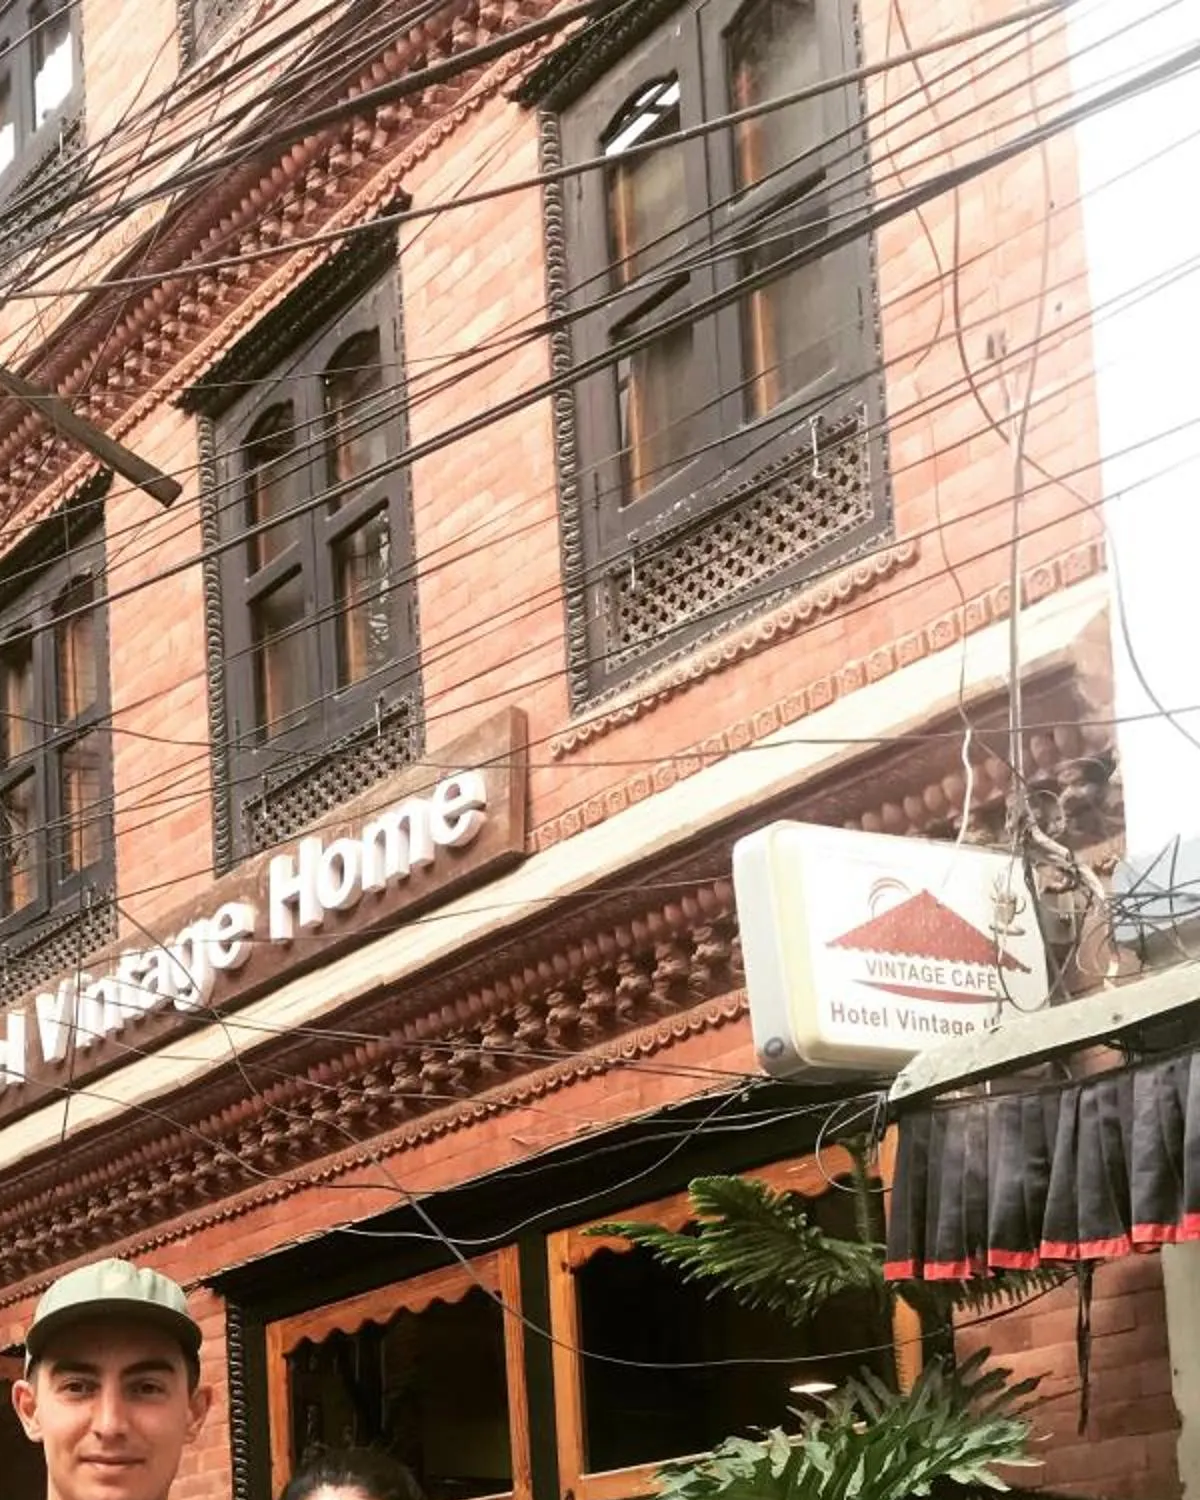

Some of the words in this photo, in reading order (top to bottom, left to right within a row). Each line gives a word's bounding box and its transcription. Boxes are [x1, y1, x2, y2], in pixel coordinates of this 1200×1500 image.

[35, 902, 257, 1062] Vintage
[269, 769, 488, 941] Home
[866, 958, 946, 985] VINTAGE
[831, 1001, 888, 1026] Hotel
[897, 1008, 975, 1037] Vintage
